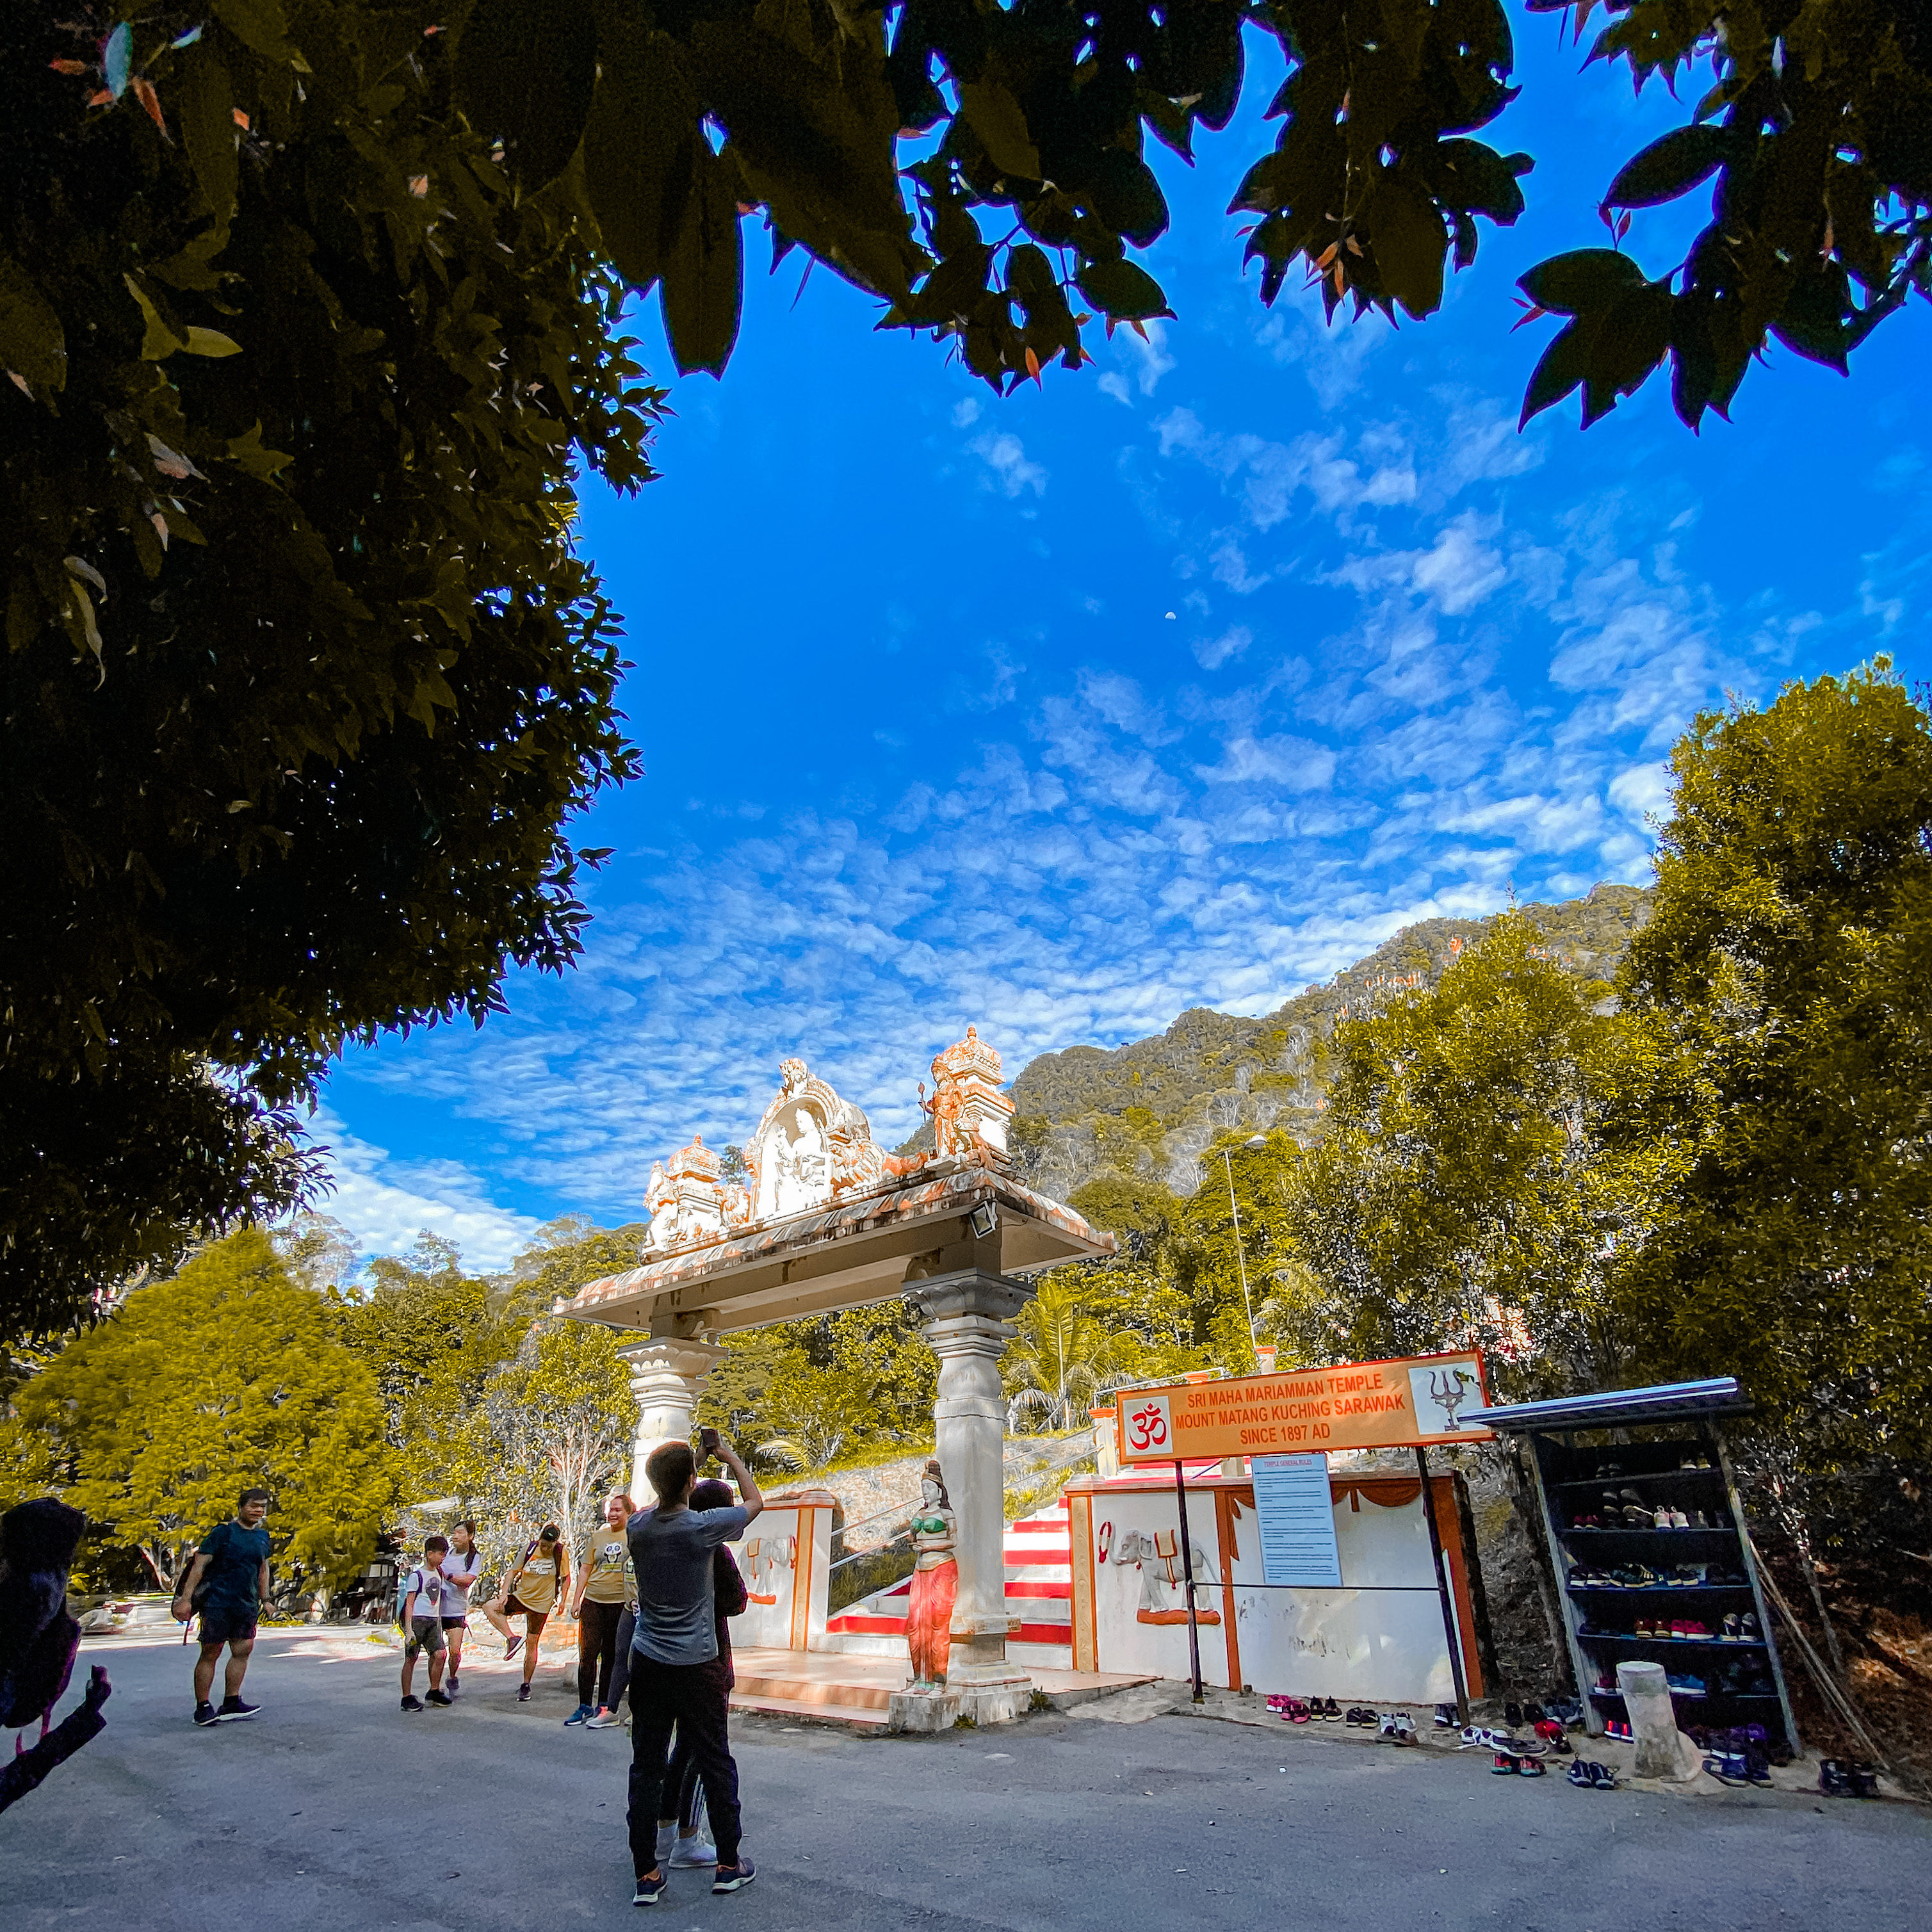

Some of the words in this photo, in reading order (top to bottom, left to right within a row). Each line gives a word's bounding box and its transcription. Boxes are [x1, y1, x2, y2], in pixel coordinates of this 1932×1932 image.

[1188, 1393, 1206, 1408] SRI
[1209, 1389, 1244, 1406] MAHA
[1246, 1379, 1324, 1402] MARIAMMAN
[1327, 1374, 1383, 1394] TEMPLE
[1175, 1412, 1215, 1429] MOUNT
[1219, 1407, 1268, 1425] MATANG
[1271, 1400, 1331, 1421] KUCHING
[1334, 1393, 1406, 1415] SARAWAK
[1240, 1427, 1278, 1445] SINCE
[1281, 1425, 1307, 1441] 1897
[1313, 1423, 1331, 1439] AD
